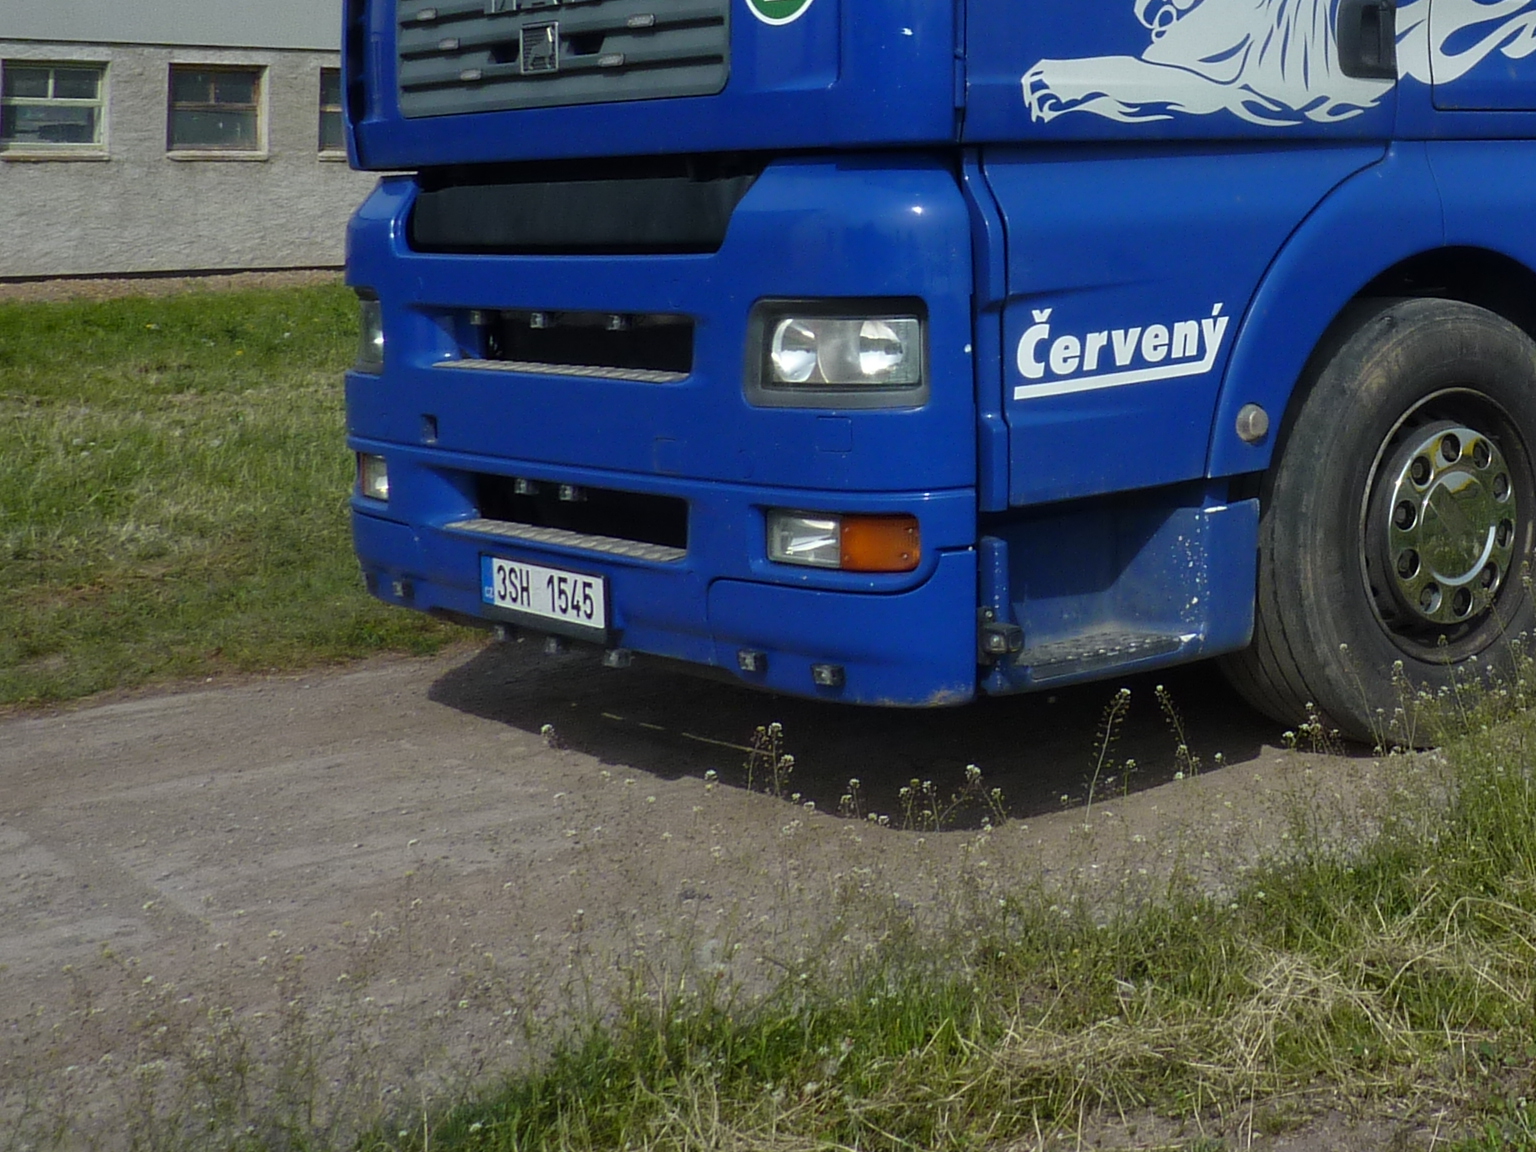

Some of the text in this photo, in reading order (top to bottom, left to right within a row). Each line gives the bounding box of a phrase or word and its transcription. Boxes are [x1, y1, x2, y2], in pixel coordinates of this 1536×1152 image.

[1013, 302, 1230, 401] Červený
[497, 564, 531, 608] 3SH
[546, 574, 594, 620] 1545
